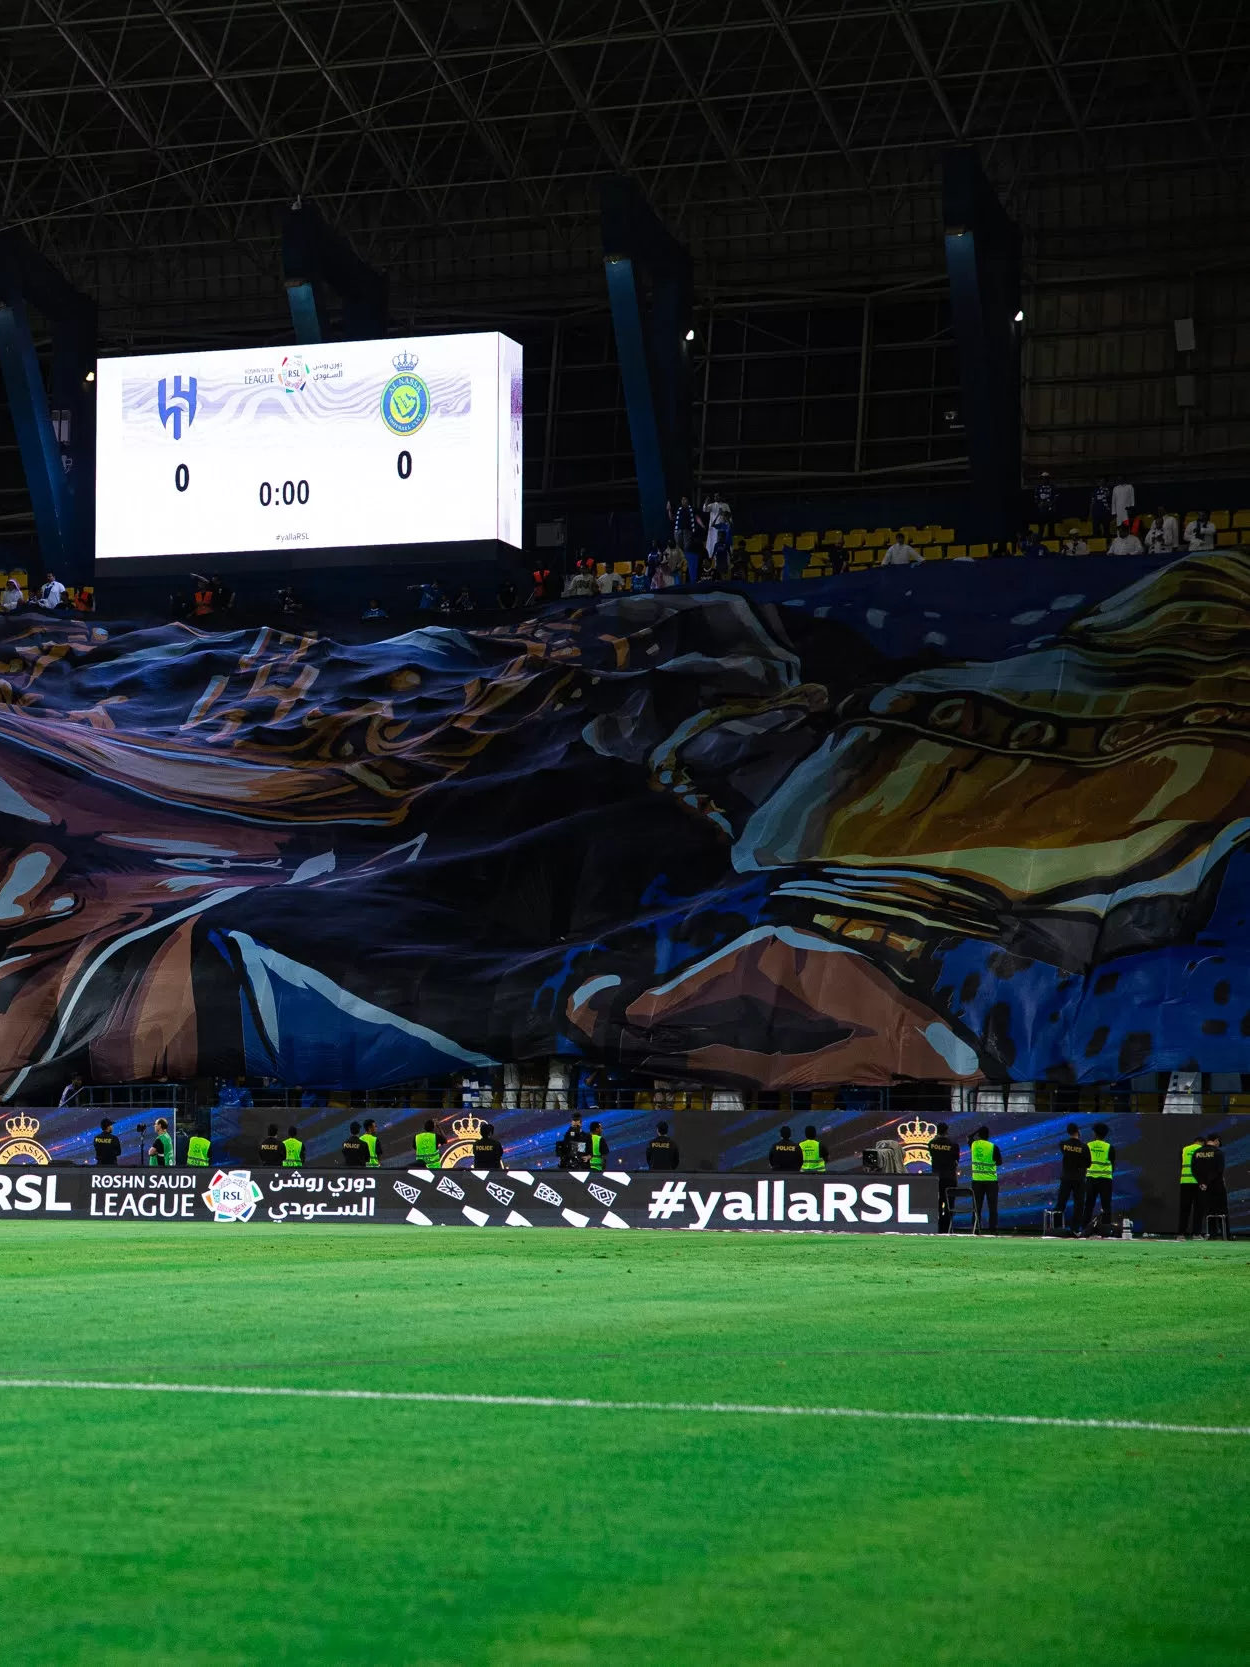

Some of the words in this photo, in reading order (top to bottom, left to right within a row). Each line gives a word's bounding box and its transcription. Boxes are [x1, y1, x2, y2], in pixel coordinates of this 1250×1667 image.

[244, 374, 275, 385] LEAGUE
[288, 369, 301, 378] RSL
[397, 450, 412, 479] 0
[175, 463, 190, 492] 0
[259, 479, 310, 506] 0:00
[276, 532, 310, 543] #yallaRSL
[2, 1149, 14, 1163] AL
[14, 1144, 44, 1162] NASSR
[908, 1150, 931, 1161] NAS
[930, 1143, 952, 1151] POLICE
[1063, 1144, 1083, 1153] POLICE
[91, 1174, 145, 1189] ROSHN
[149, 1175, 197, 1189] SAUDI
[269, 1170, 324, 1193] روشن
[327, 1173, 376, 1199] دوري
[89, 1193, 195, 1217] LEAGUE
[222, 1191, 242, 1201] RSL
[648, 1179, 930, 1230] #yallaRSL
[268, 1196, 376, 1223] السعودي
